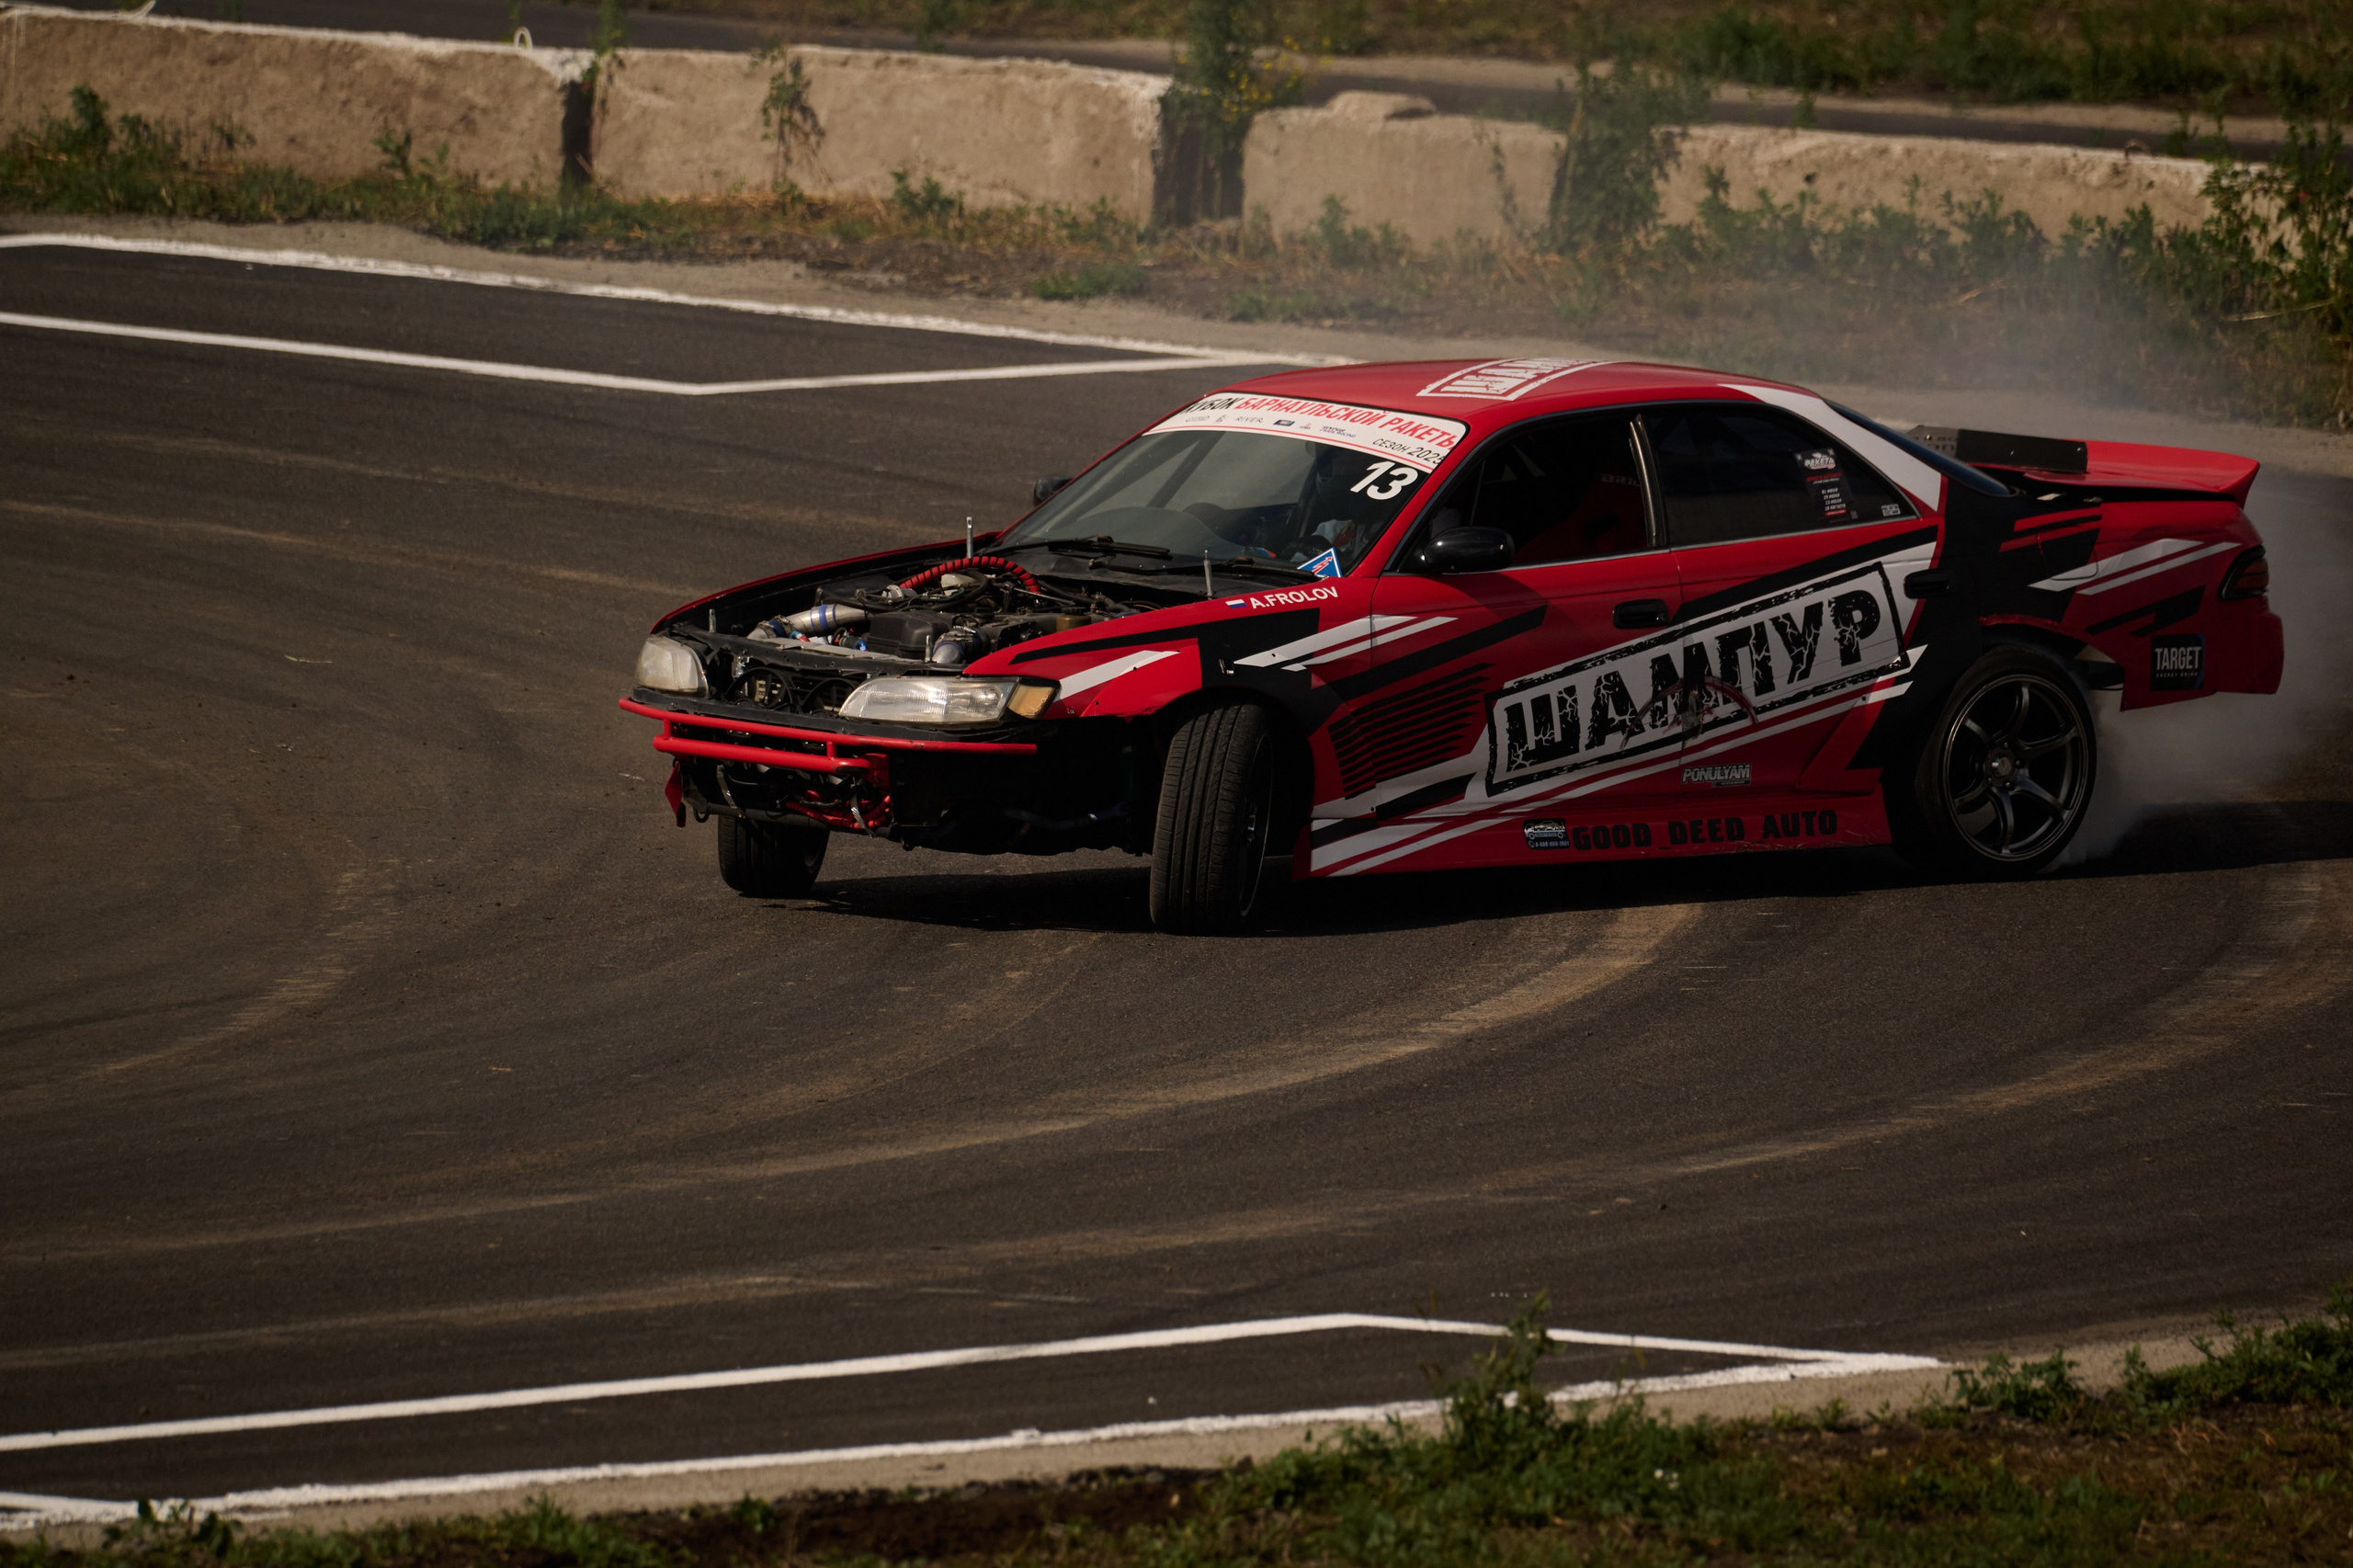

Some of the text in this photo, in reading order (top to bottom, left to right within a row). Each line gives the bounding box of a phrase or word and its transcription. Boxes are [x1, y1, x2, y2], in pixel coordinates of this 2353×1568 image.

[1233, 397, 1389, 426] БАРНАУЛЬСКОЙ
[1372, 437, 1412, 453] СЕЗОН
[1350, 460, 1418, 501] 13
[1250, 585, 1338, 609] A.FROLOV
[2154, 646, 2202, 671] TARGET
[1504, 588, 1881, 773] ШАМПУР
[1682, 763, 1751, 783] PONULYAM
[1572, 809, 1837, 851] GOOD DEED AUTO
